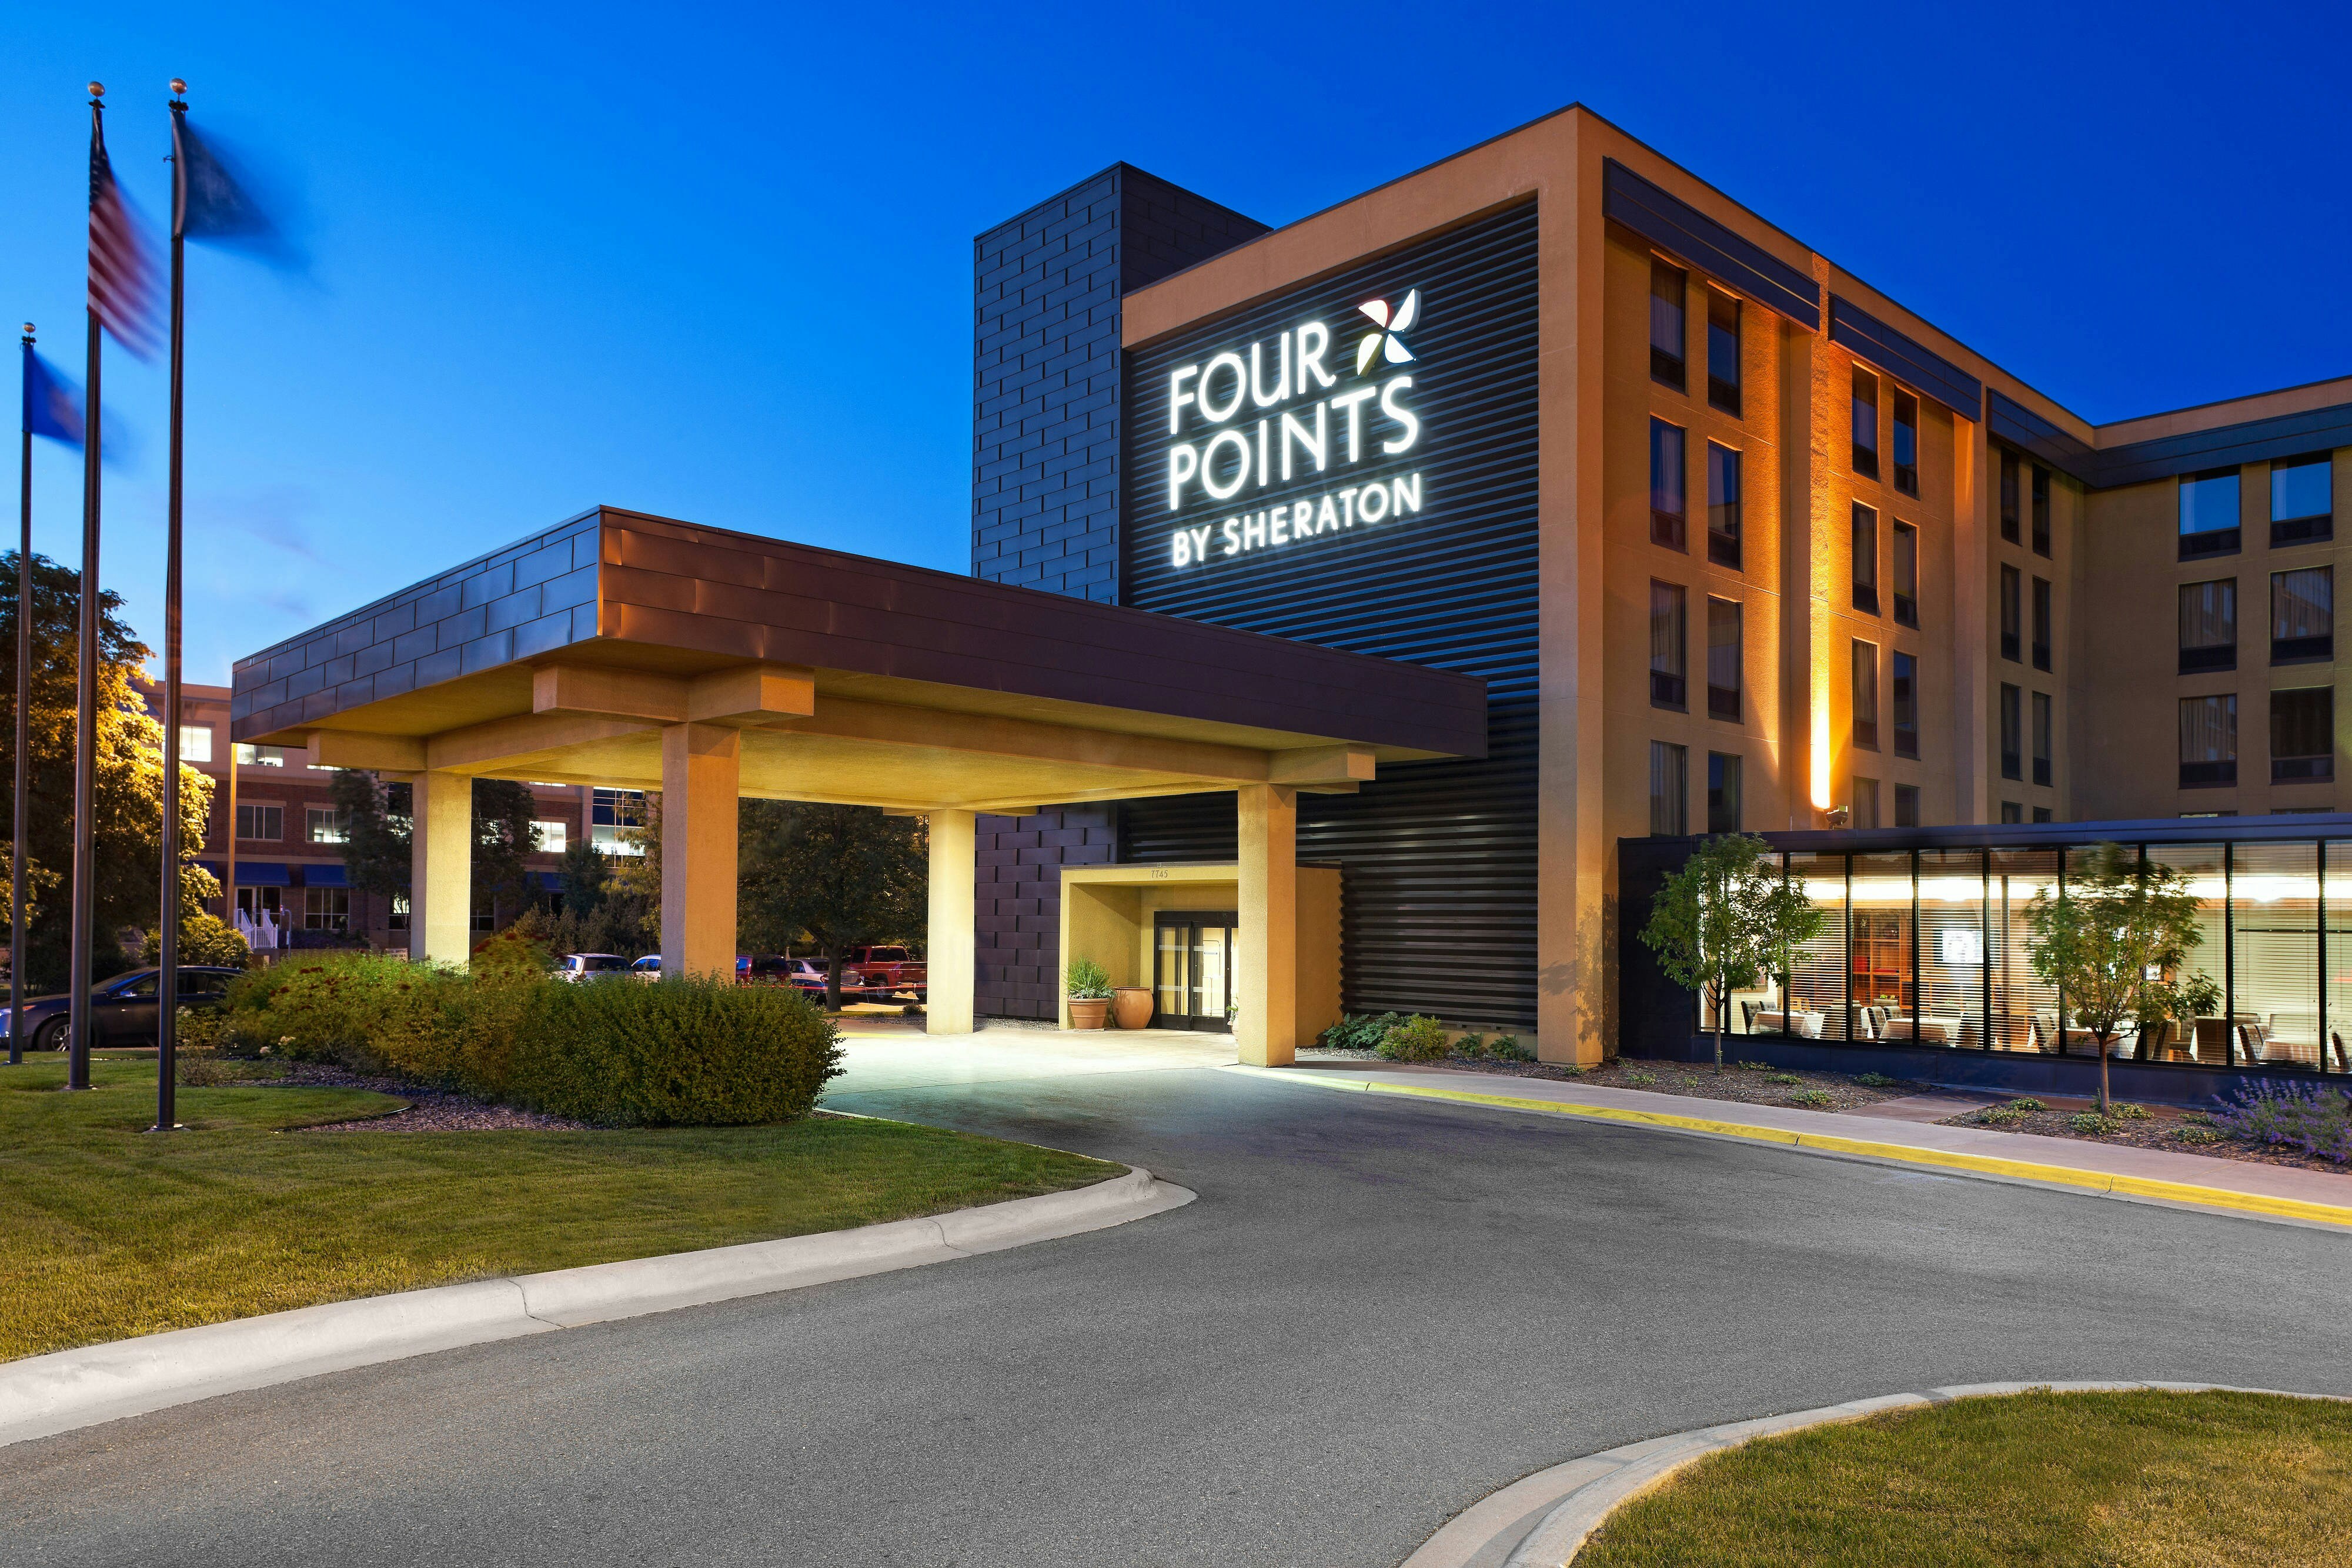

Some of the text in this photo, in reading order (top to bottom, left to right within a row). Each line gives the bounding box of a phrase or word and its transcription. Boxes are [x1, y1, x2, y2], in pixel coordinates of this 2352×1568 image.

[1170, 321, 1337, 435] FOUR
[1170, 376, 1419, 510] POINTS
[1173, 472, 1421, 567] BY SHERATON
[1151, 870, 1168, 878] 7745
